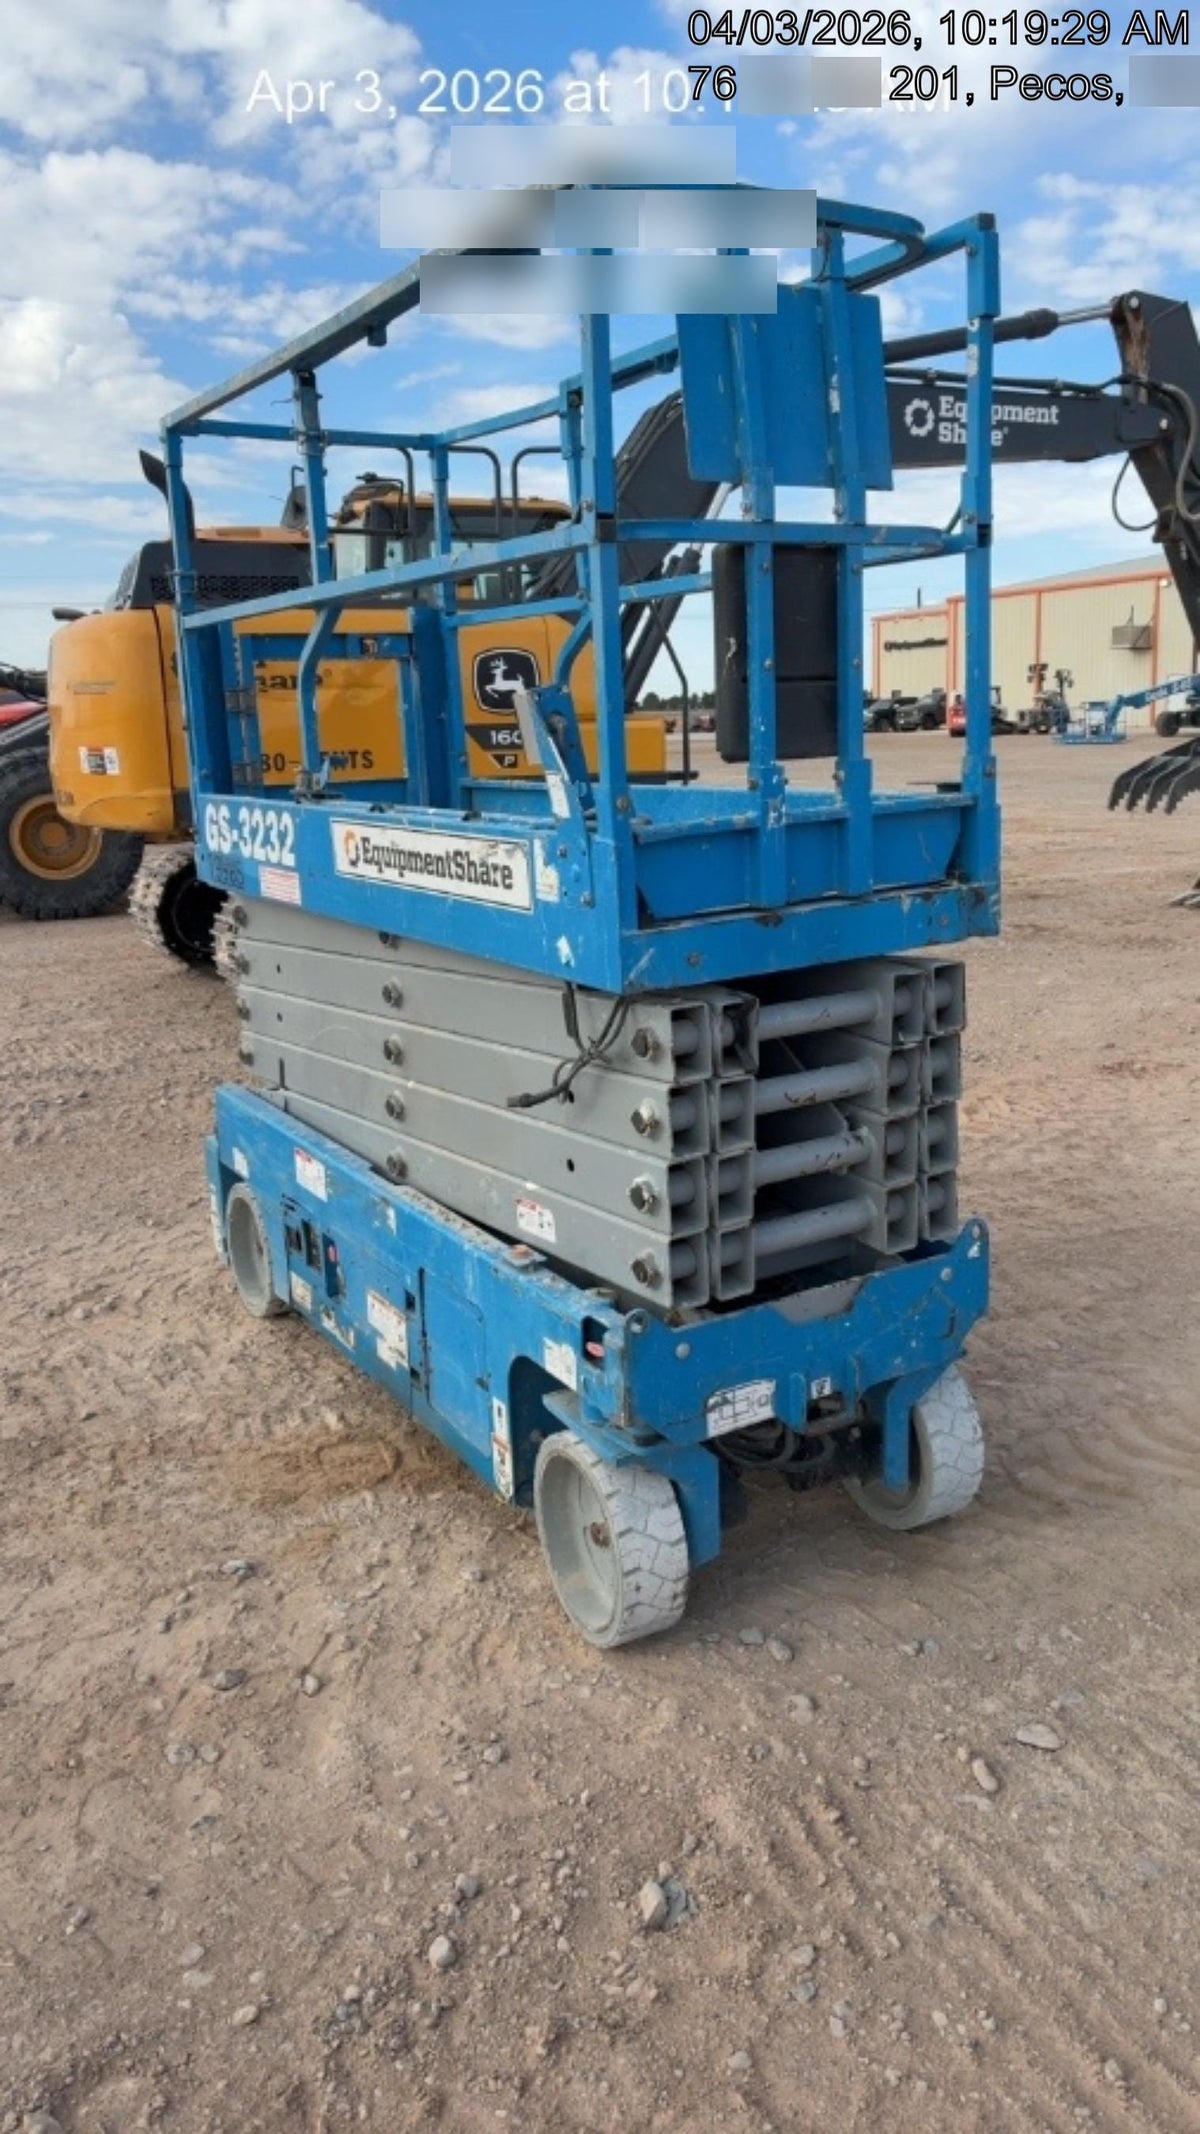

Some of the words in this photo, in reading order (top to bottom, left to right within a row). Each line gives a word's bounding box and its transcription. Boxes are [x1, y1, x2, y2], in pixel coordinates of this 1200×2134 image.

[938, 395, 1060, 425] Eqpment
[938, 421, 1003, 447] She
[205, 802, 296, 867] GS-3232
[360, 836, 514, 890] EquipmentShare
